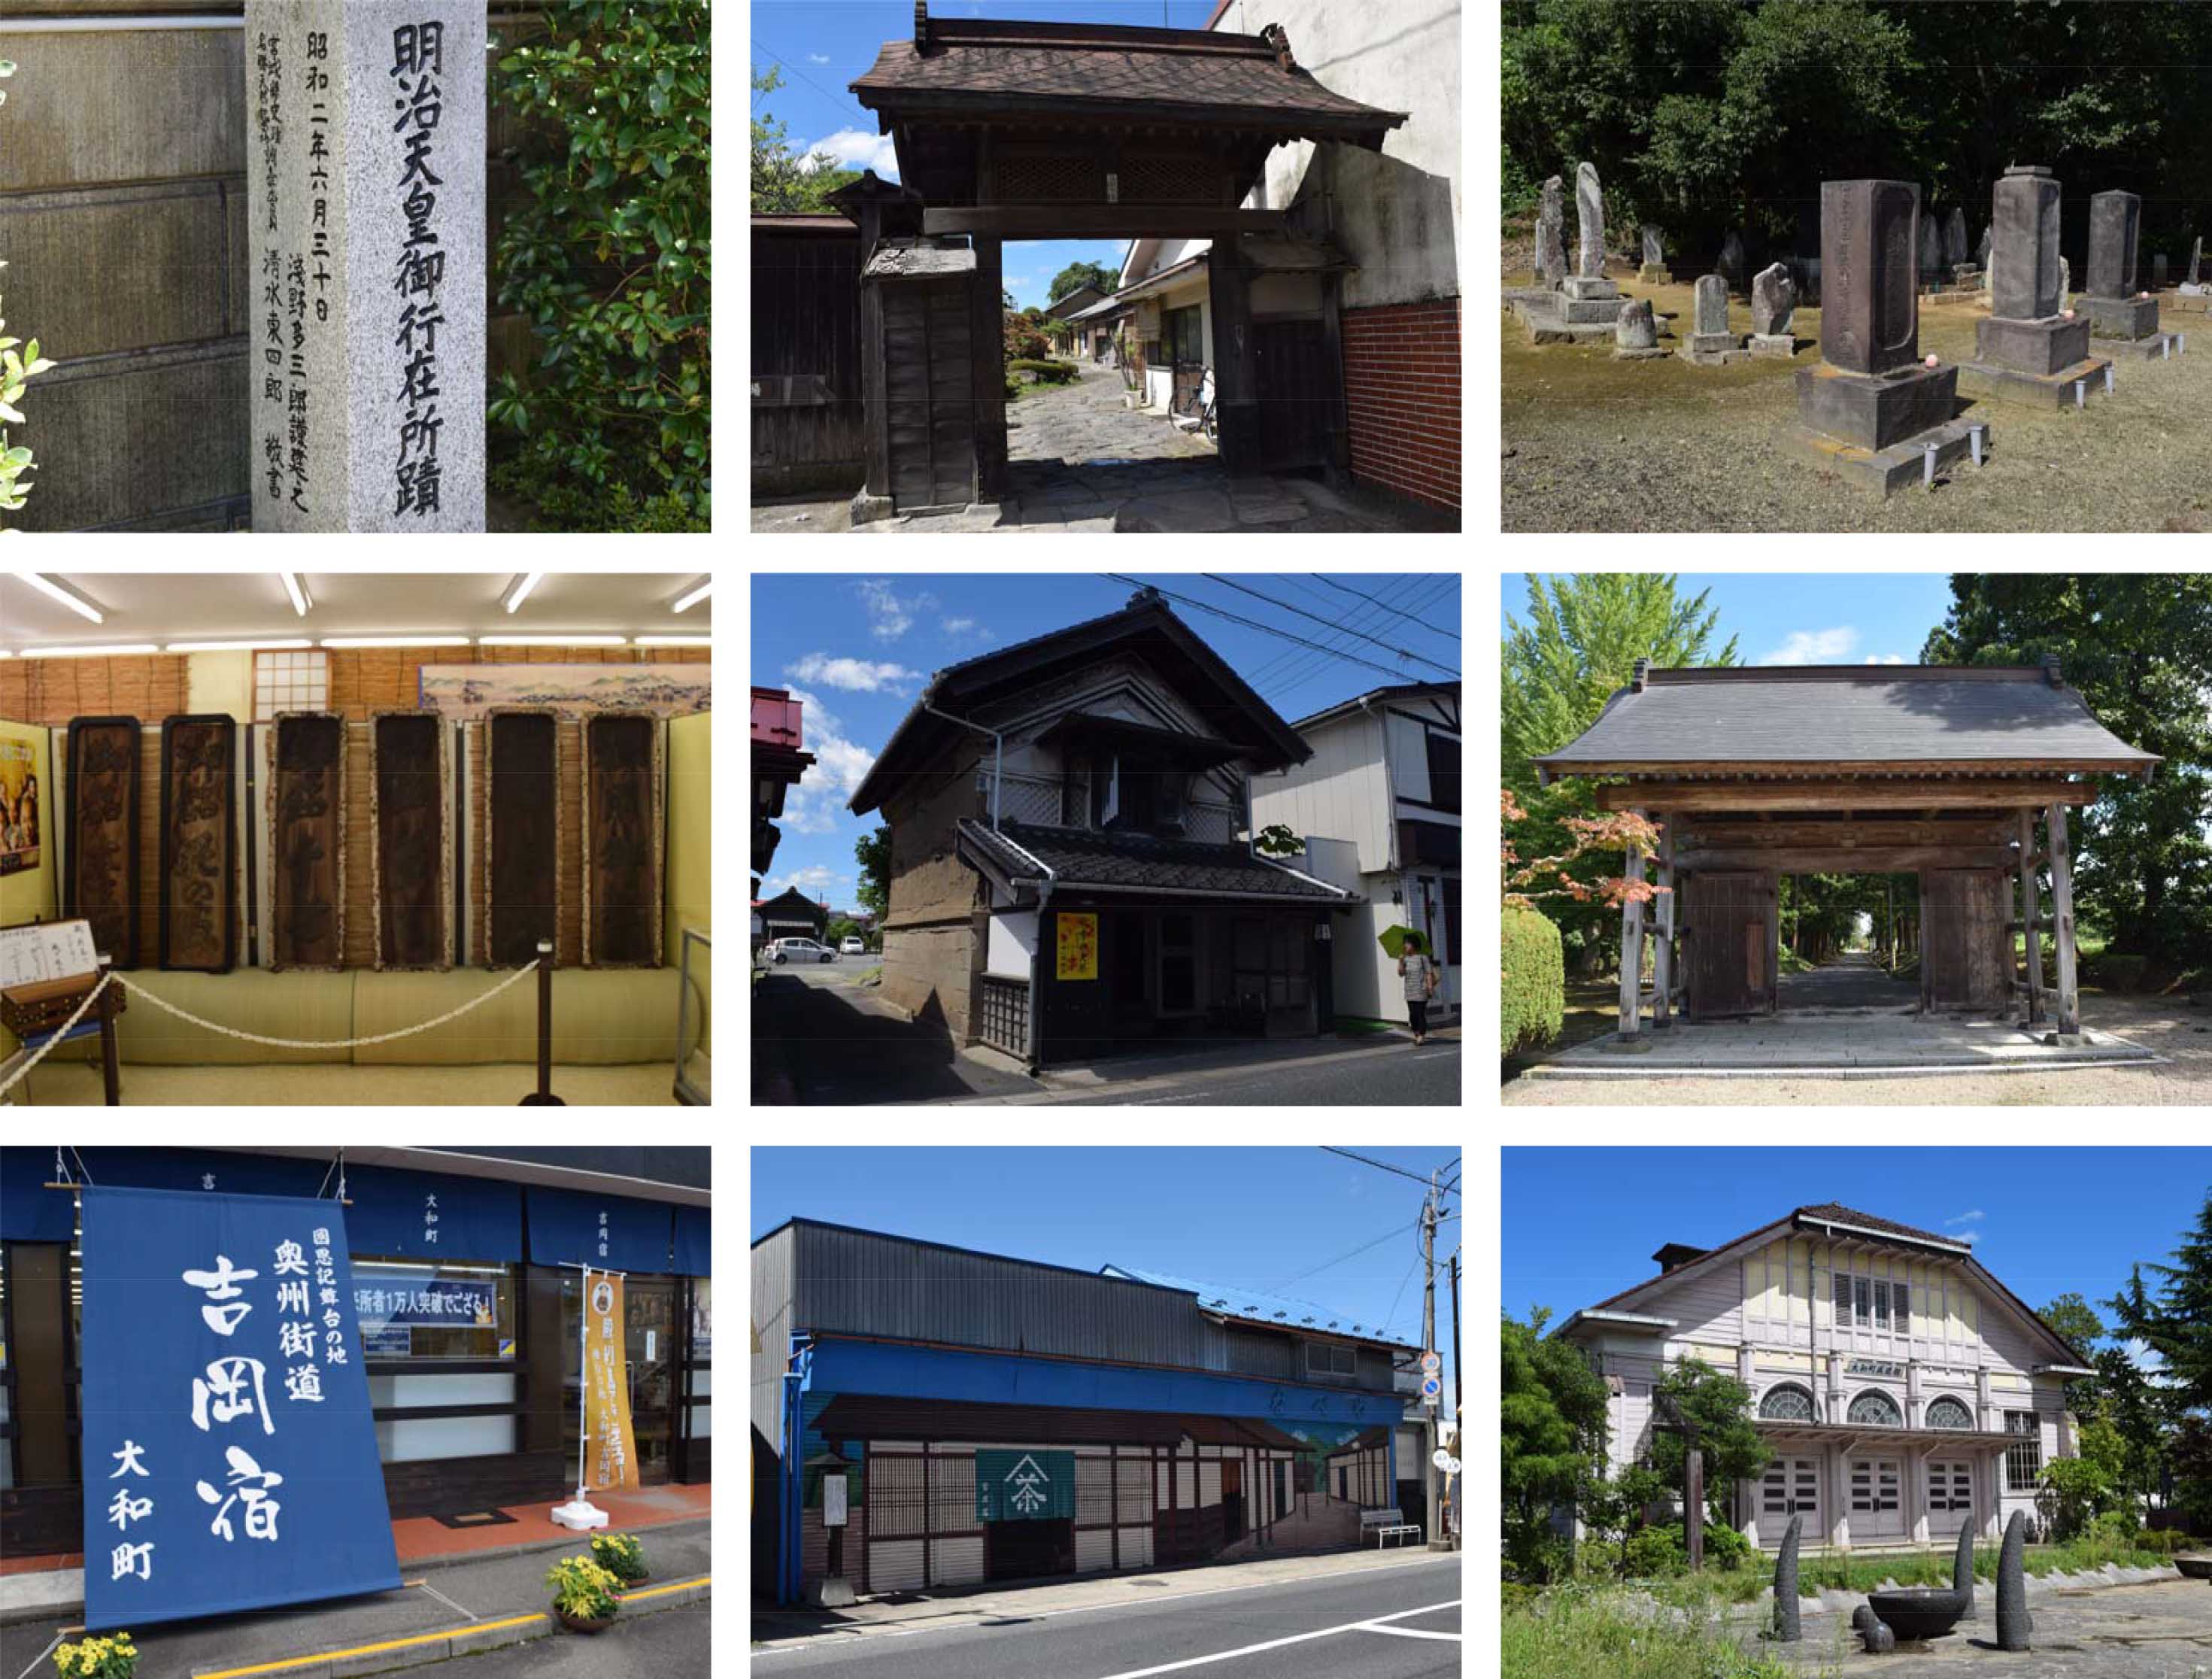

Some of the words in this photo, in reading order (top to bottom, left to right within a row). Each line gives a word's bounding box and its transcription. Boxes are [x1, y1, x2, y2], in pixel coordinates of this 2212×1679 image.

[305, 31, 331, 321] 昭和二年六月三十日
[390, 21, 445, 517] 明治天皇御行在所蹟
[424, 1193, 439, 1243] 大和町
[182, 1255, 283, 1541] 吉岡宿
[273, 1238, 326, 1401] 奥州街道
[108, 1440, 155, 1580] 大和町
[1010, 1472, 1048, 1514] 茶
